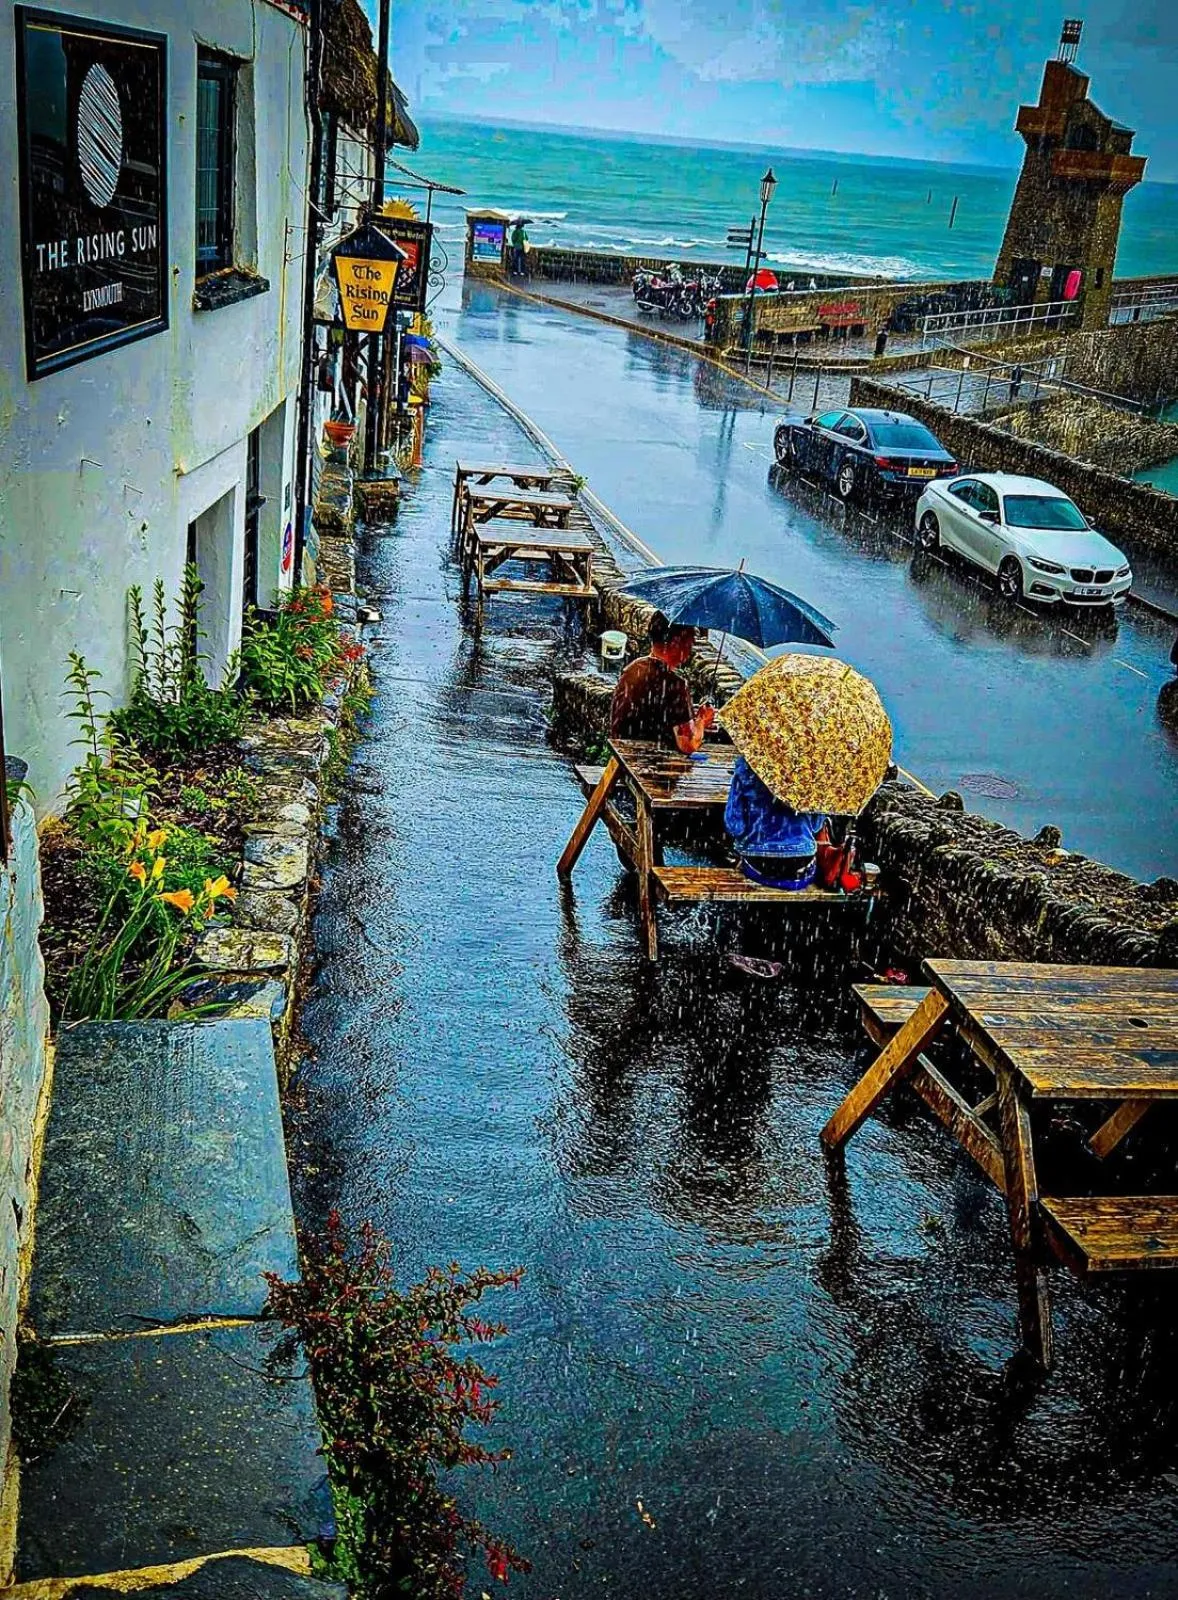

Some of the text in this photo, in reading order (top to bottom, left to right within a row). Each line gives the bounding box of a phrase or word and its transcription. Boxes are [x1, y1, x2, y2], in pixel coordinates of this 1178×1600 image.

[36, 224, 157, 272] THE RISING SUN
[351, 264, 382, 281] The
[83, 281, 123, 312] LYNMOUTH
[345, 284, 389, 305] Rising
[350, 304, 379, 322] Sun
